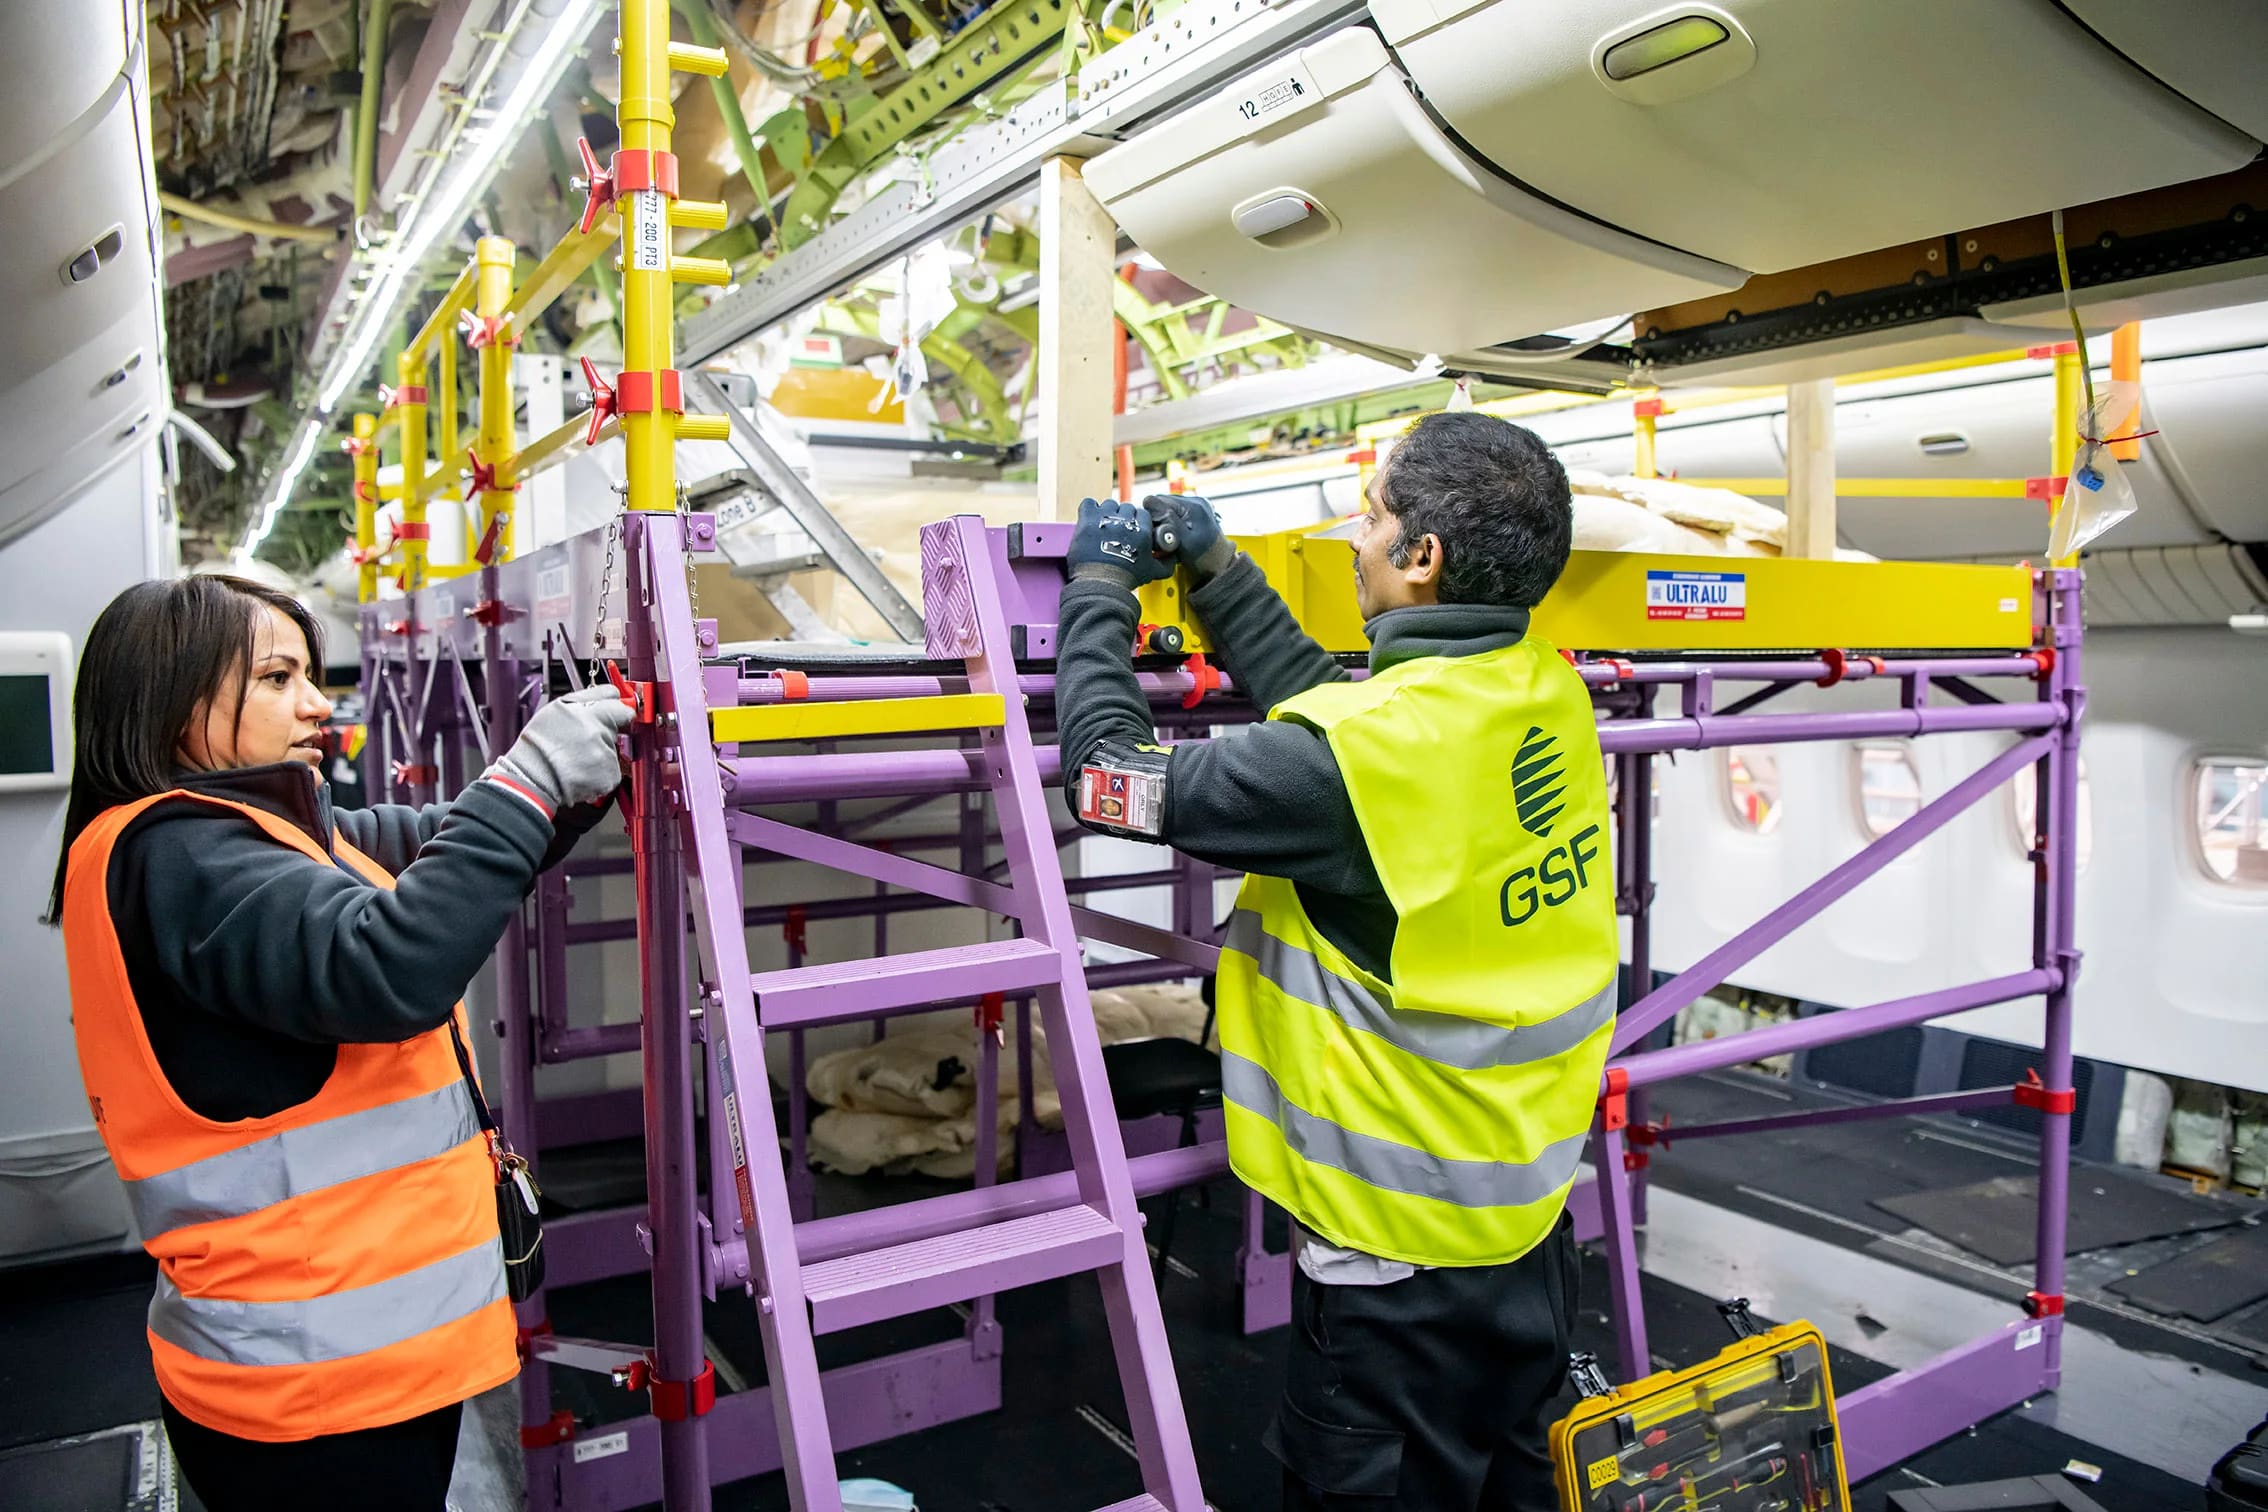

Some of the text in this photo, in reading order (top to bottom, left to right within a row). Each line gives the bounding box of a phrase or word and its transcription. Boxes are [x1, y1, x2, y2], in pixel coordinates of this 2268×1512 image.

[1239, 100, 1260, 120] 12
[645, 222, 657, 242] 200
[645, 246, 657, 266] PT3
[1666, 583, 1727, 604] ULTRALU
[1500, 823, 1600, 927] GSF
